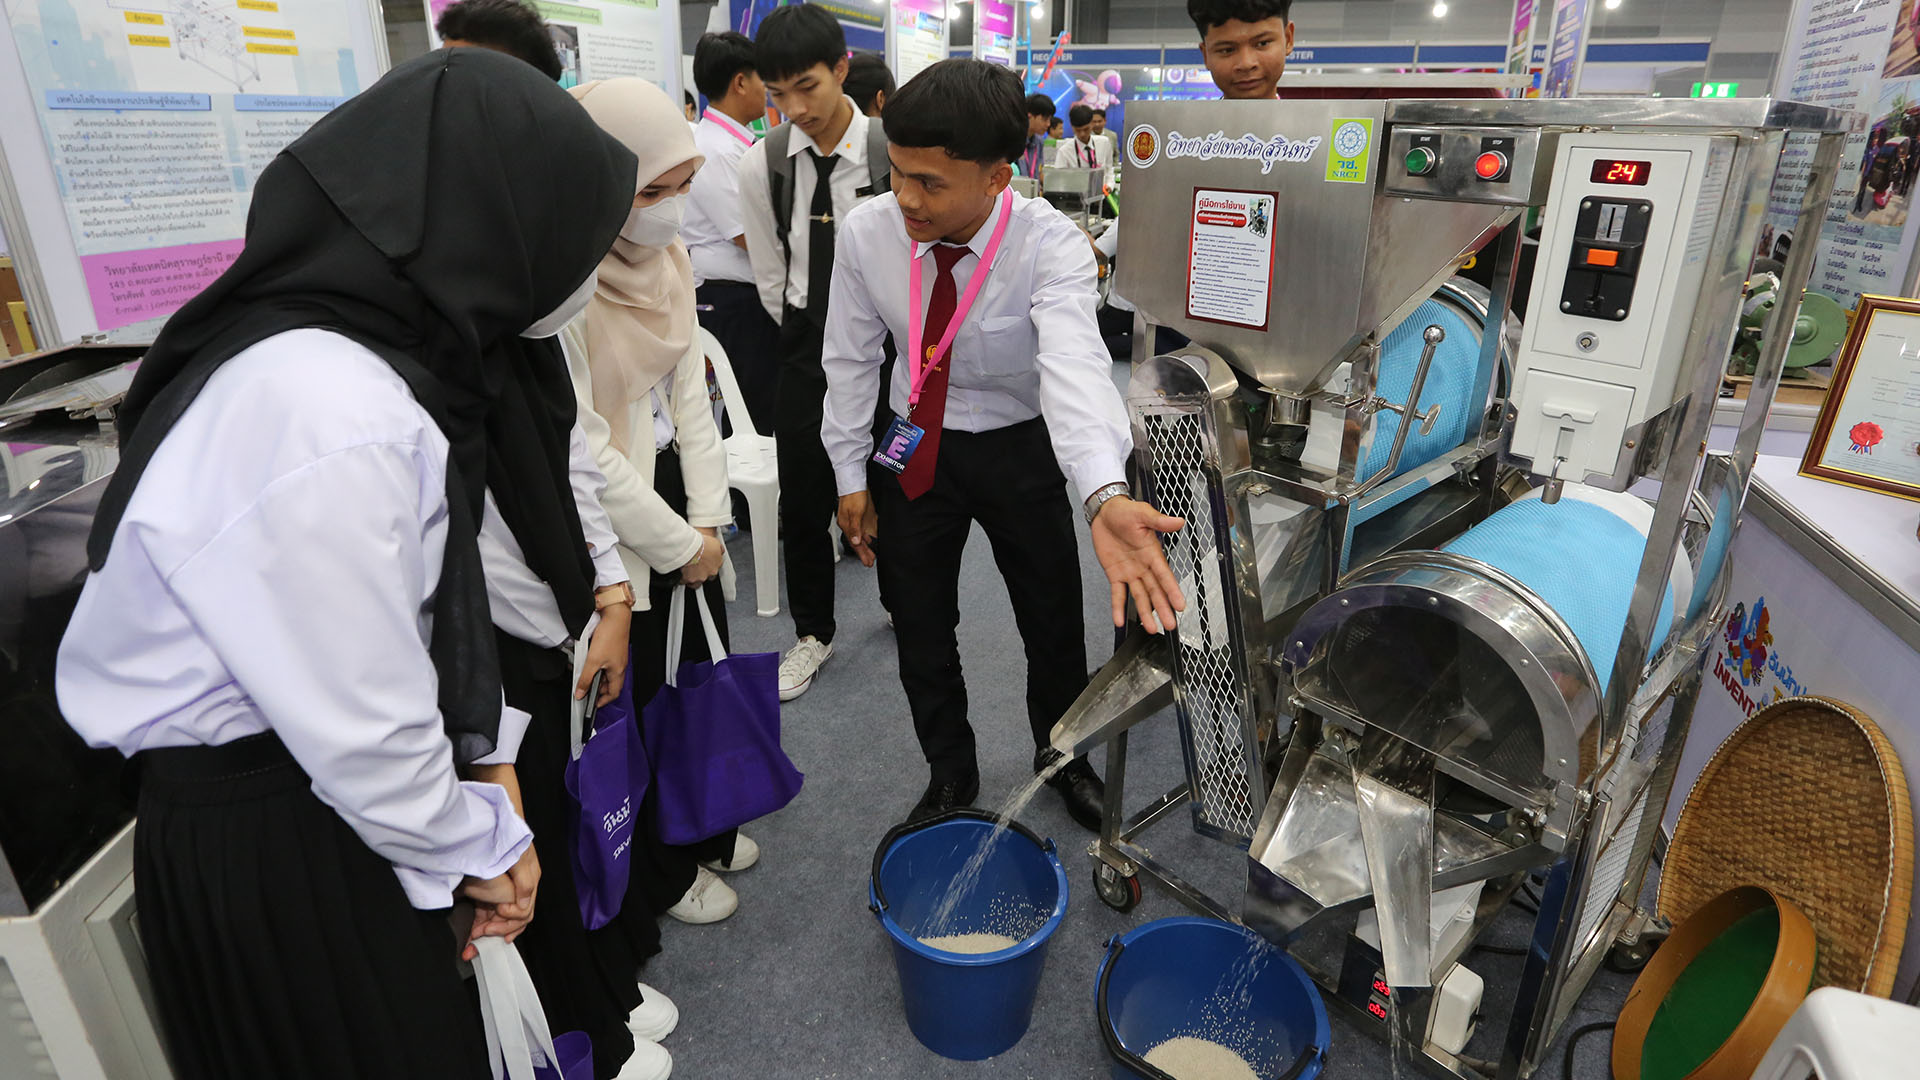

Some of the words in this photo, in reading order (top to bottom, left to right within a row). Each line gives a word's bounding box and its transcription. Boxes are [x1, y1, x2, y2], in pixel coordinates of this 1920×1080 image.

[1167, 131, 1321, 172] วิทยาลัยเทคนิคสุรินทร์
[1198, 197, 1246, 210] คู่มือการใช้งาน
[887, 434, 910, 460] E
[876, 451, 905, 471] EXHIBITOR
[1768, 650, 1807, 696] วันนัก
